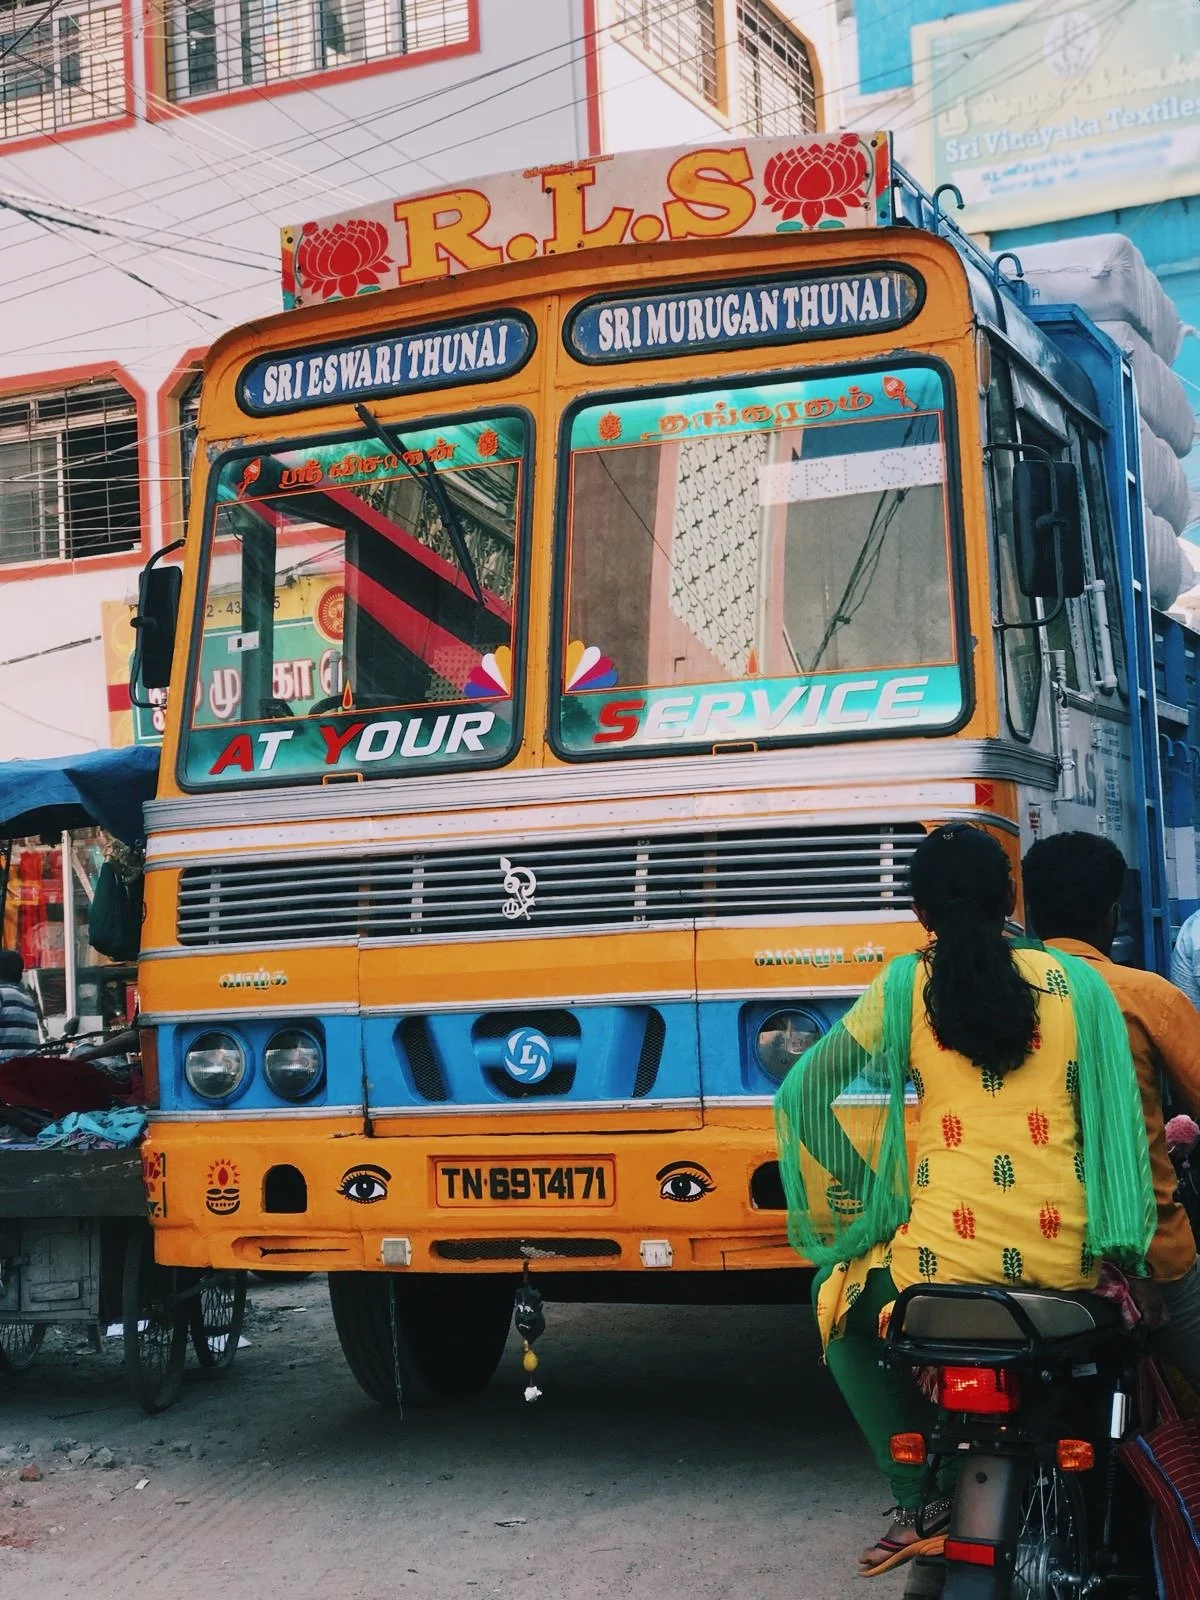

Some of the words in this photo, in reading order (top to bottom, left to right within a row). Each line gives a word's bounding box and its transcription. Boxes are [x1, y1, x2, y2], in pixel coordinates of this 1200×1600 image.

[945, 133, 980, 164] Sri
[985, 115, 1102, 155] Vinayaka
[598, 305, 643, 352] SRI
[646, 290, 780, 346] MURUGAN
[782, 276, 891, 329] THUNAI
[262, 363, 304, 406] SRI
[307, 352, 404, 396] ESWARI
[405, 325, 509, 381] THUNAI
[593, 675, 930, 743] SERVICE
[209, 729, 293, 776] AT
[319, 711, 496, 765] YOUR
